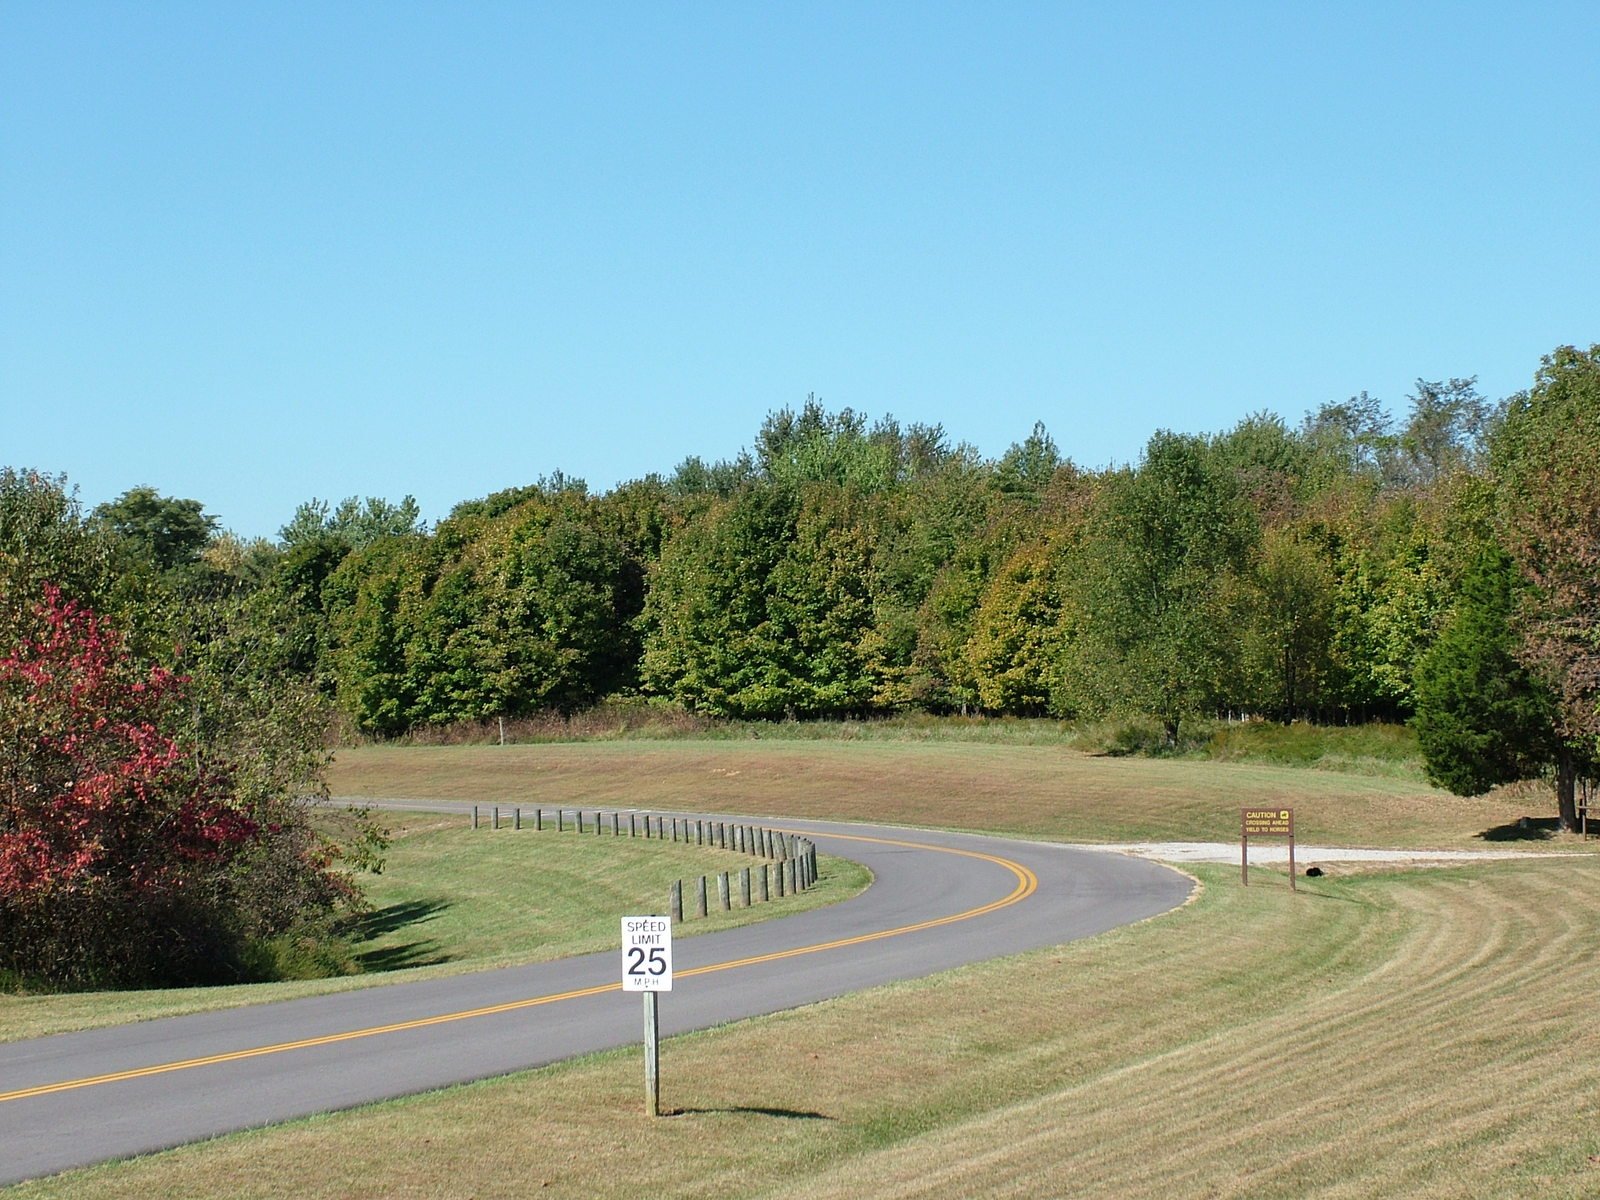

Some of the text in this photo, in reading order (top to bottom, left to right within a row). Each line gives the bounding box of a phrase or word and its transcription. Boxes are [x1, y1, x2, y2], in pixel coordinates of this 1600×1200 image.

[627, 921, 666, 932] SPEED
[632, 934, 661, 944] LIMIT
[628, 947, 666, 975] 25
